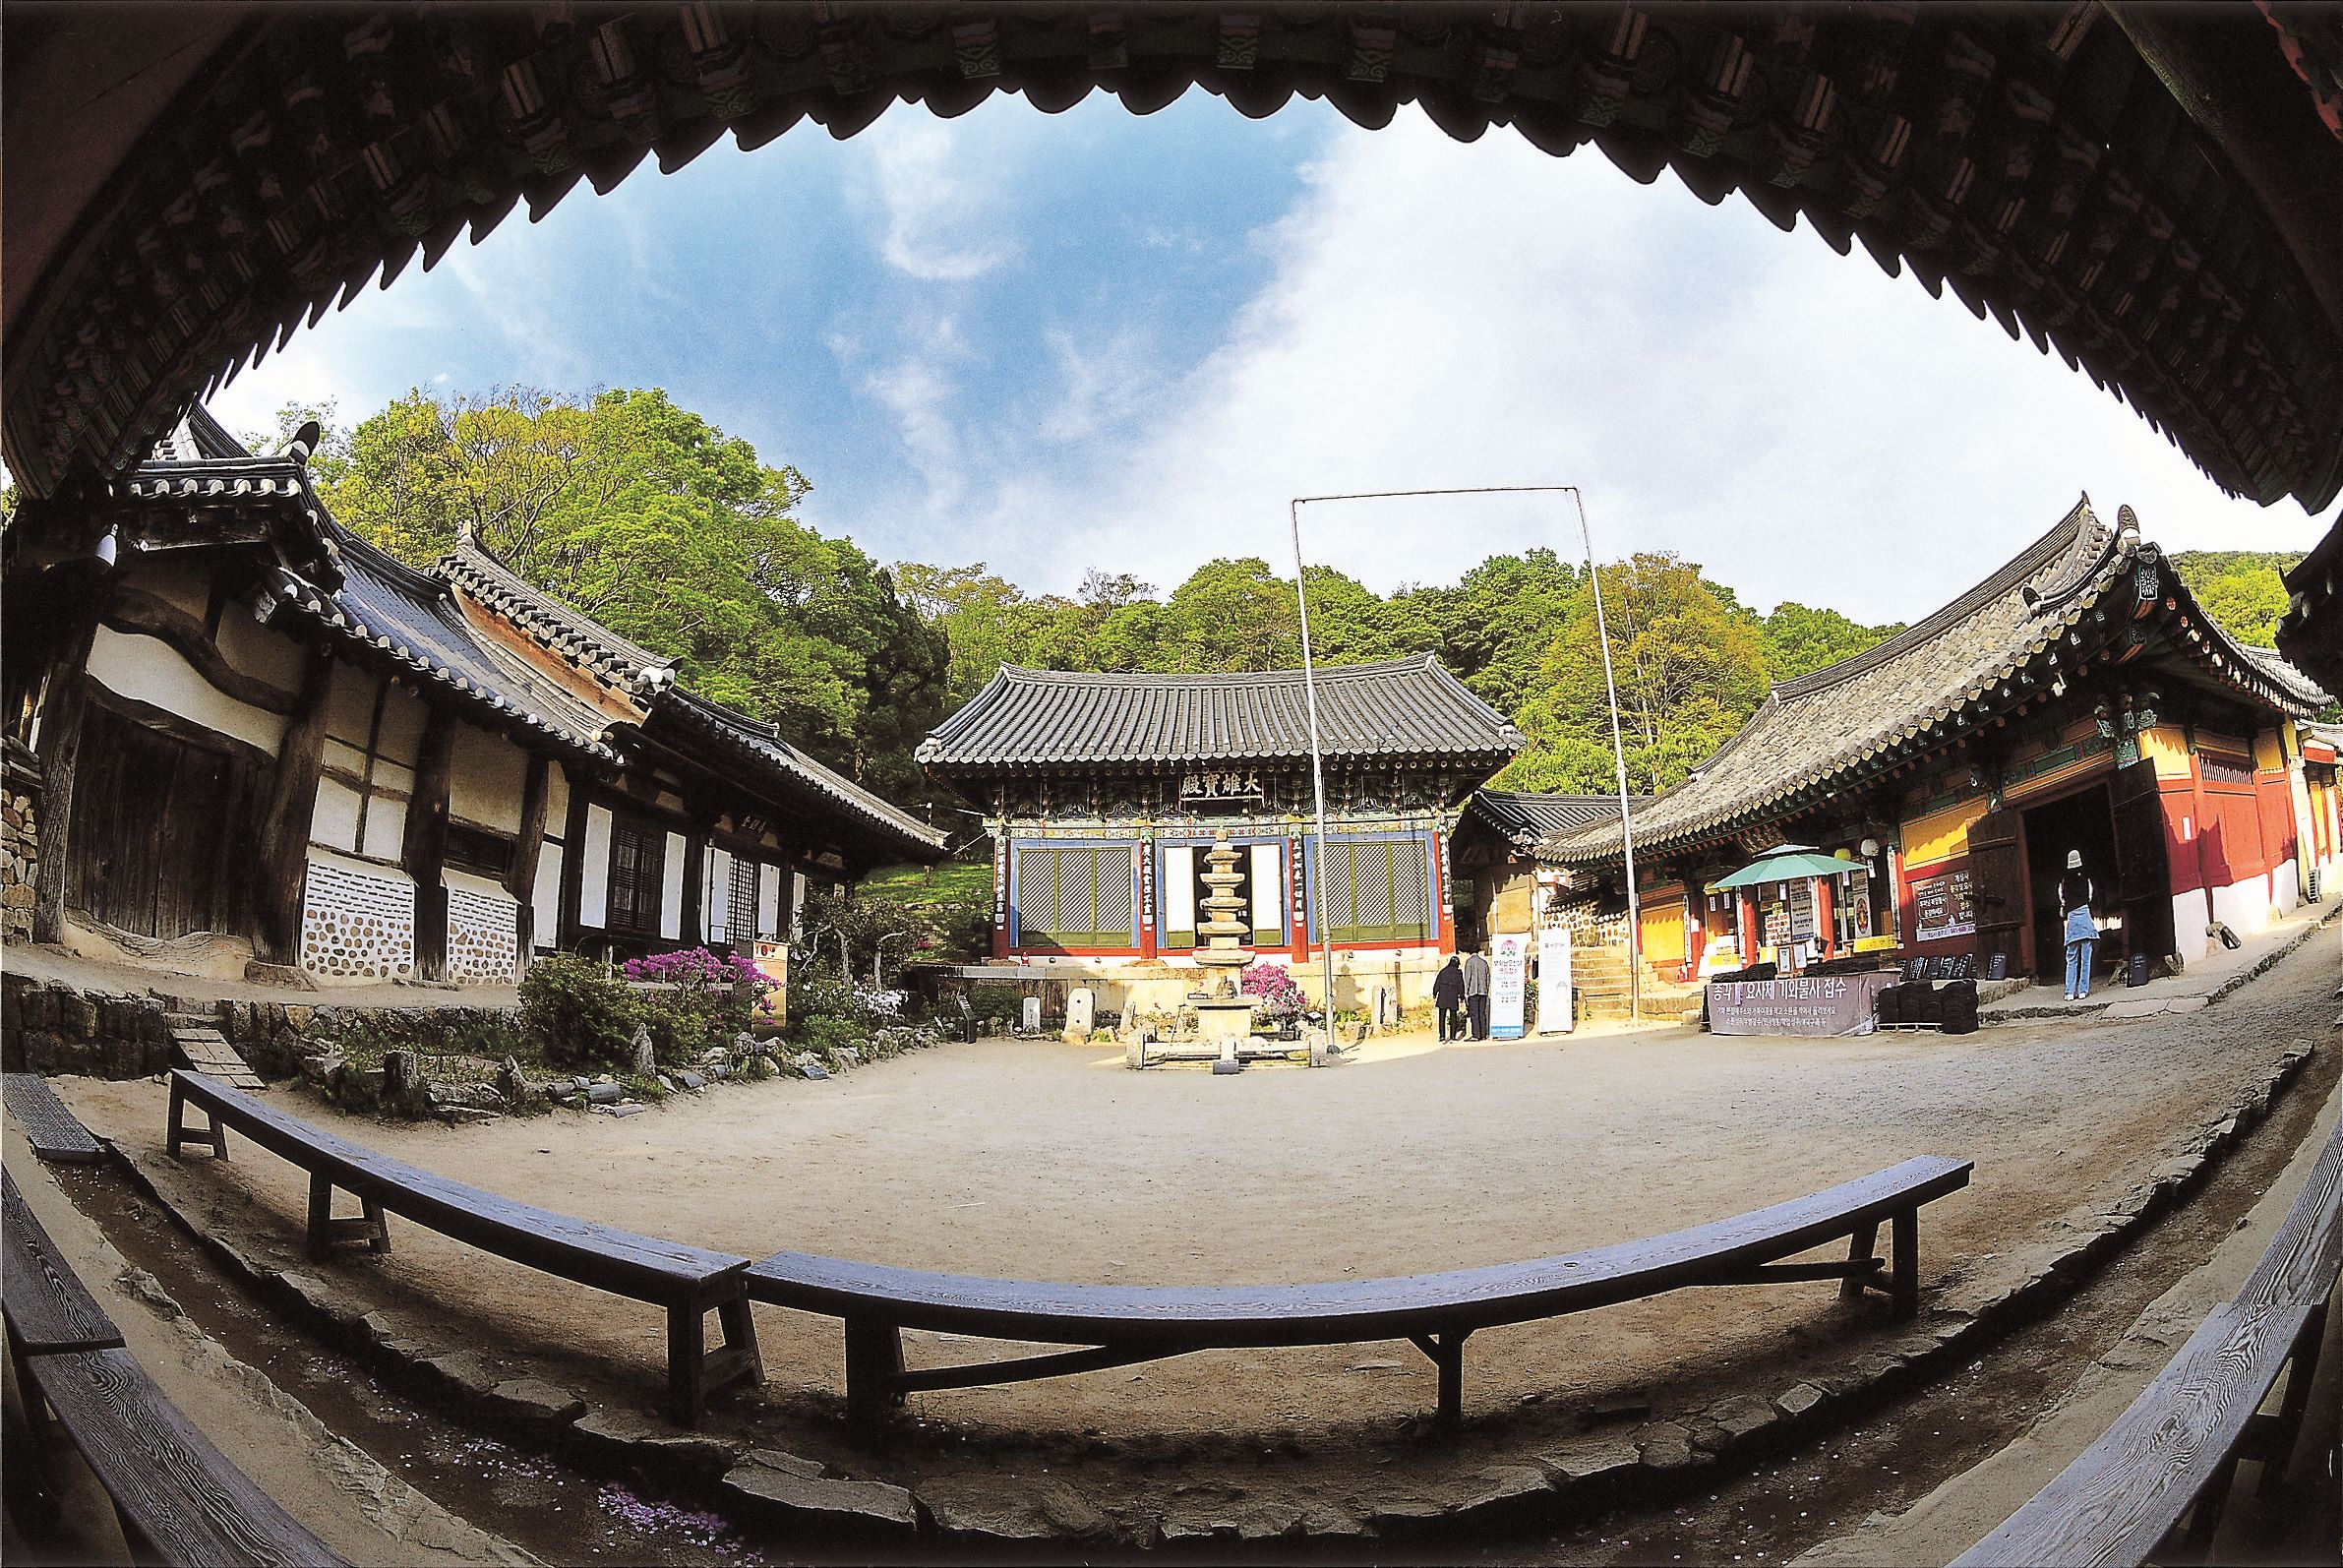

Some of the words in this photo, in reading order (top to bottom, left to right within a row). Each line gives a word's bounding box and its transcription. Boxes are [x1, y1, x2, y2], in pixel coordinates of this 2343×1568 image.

[1713, 983, 1731, 1000] 종각
[1779, 978, 1820, 999] 기와불사
[1824, 977, 1847, 998] 접수
